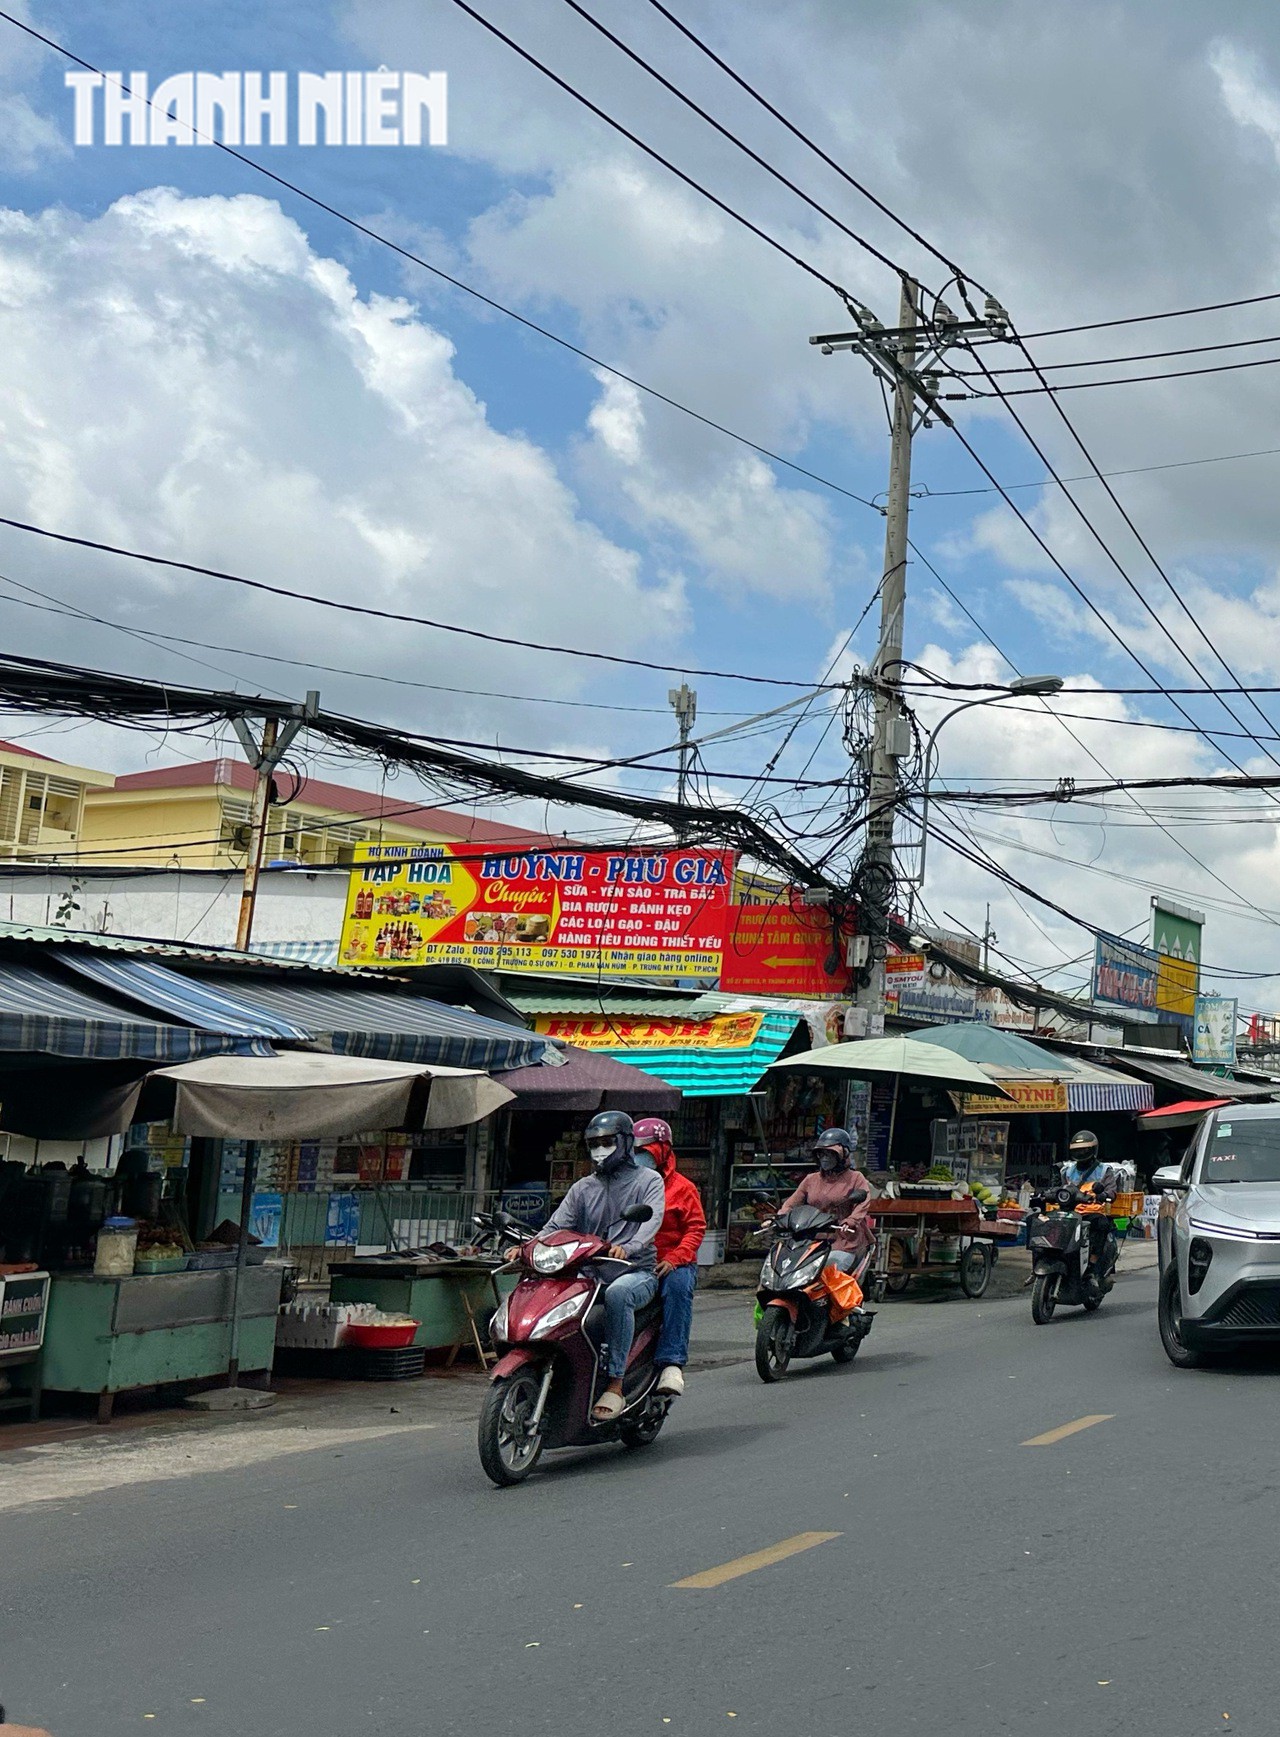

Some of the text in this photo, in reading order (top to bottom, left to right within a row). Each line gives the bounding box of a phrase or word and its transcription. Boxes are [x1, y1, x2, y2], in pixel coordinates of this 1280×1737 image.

[384, 847, 408, 858] KINH
[410, 847, 444, 859] DOANH
[675, 857, 727, 887] GIA
[563, 884, 588, 897] SỮA
[626, 885, 652, 899] SÀO
[664, 886, 687, 900] TRÀ
[561, 901, 582, 912] BIA
[630, 902, 664, 915] BÁNH
[667, 904, 691, 917] KẸO
[560, 916, 585, 928] CÁC
[618, 918, 643, 932] GẠO
[654, 918, 680, 932] ĐẬU
[558, 932, 592, 946] HÀNG
[594, 933, 624, 947] TIÊU
[625, 933, 659, 947] DÙNG
[698, 934, 722, 949] YẾU
[729, 932, 764, 944] TRUNG
[767, 930, 790, 944] TÂM
[445, 944, 465, 954] Zalo
[472, 946, 494, 955] 0908
[515, 947, 531, 957] 113
[542, 948, 558, 958] 097
[561, 949, 577, 958] 530
[611, 950, 634, 962] Nhận
[637, 951, 656, 963] giao
[659, 951, 682, 964] hàng
[684, 951, 713, 963] online
